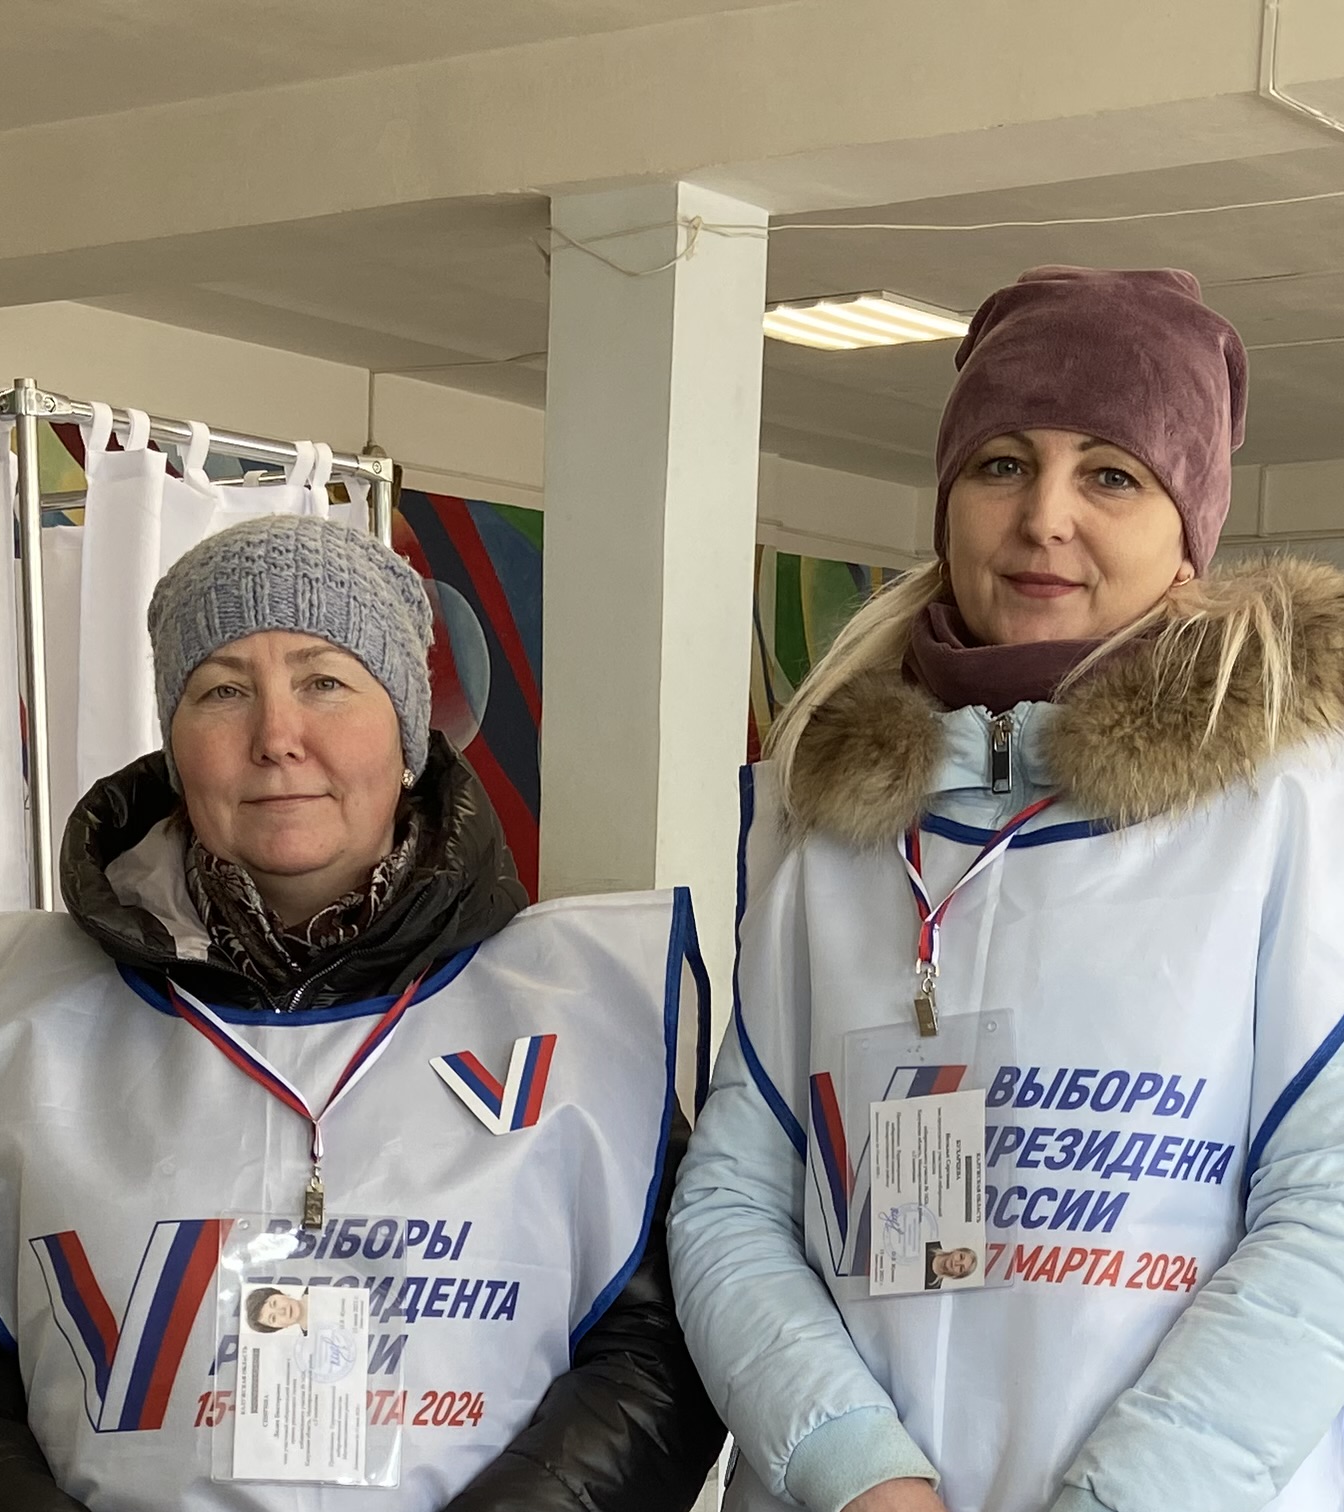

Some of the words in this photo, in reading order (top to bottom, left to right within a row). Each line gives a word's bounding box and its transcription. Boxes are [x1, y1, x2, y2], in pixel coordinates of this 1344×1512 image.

[985, 1065, 1207, 1120] ВЫБОРЫ
[1004, 1244, 1127, 1288] МАРТА
[1124, 1252, 1198, 1293] 2024
[412, 1390, 485, 1427] 2024
